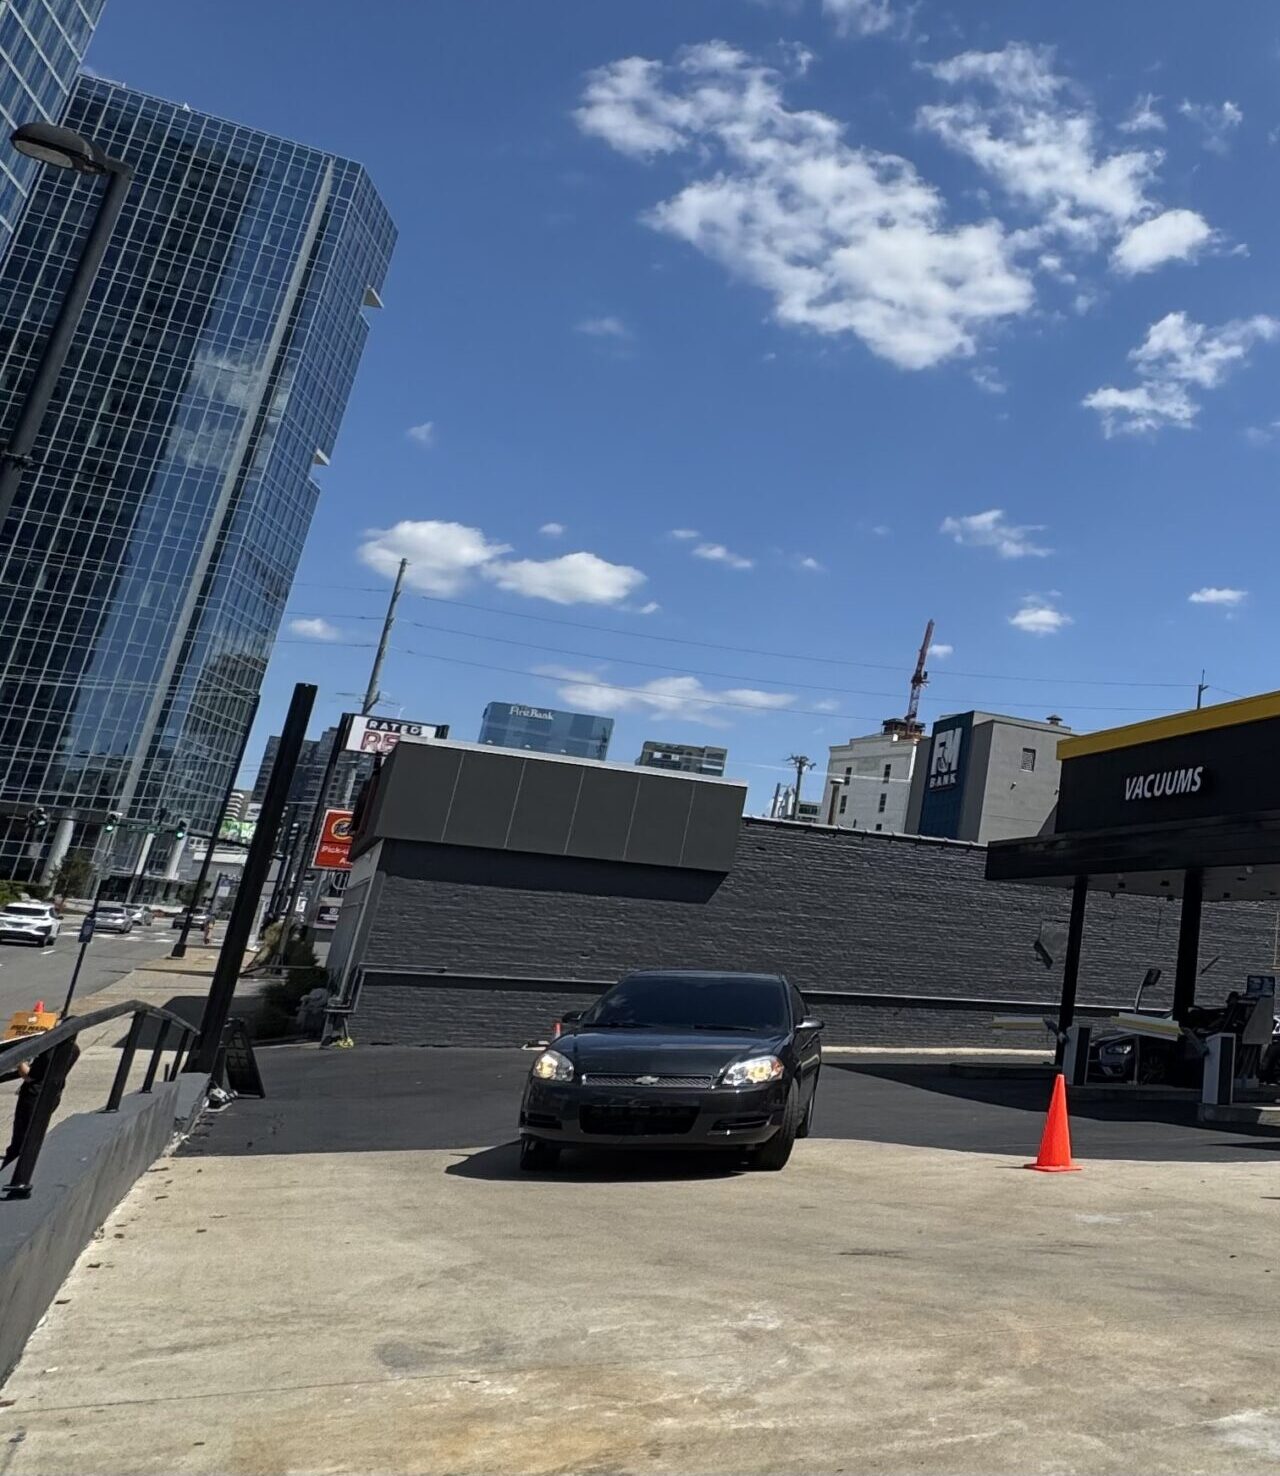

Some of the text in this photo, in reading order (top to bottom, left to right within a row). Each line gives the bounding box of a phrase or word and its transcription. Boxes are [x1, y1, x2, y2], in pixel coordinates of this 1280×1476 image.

[368, 720, 422, 735] RATED
[929, 773, 957, 789] BANK
[1124, 766, 1204, 801] VACUUMS
